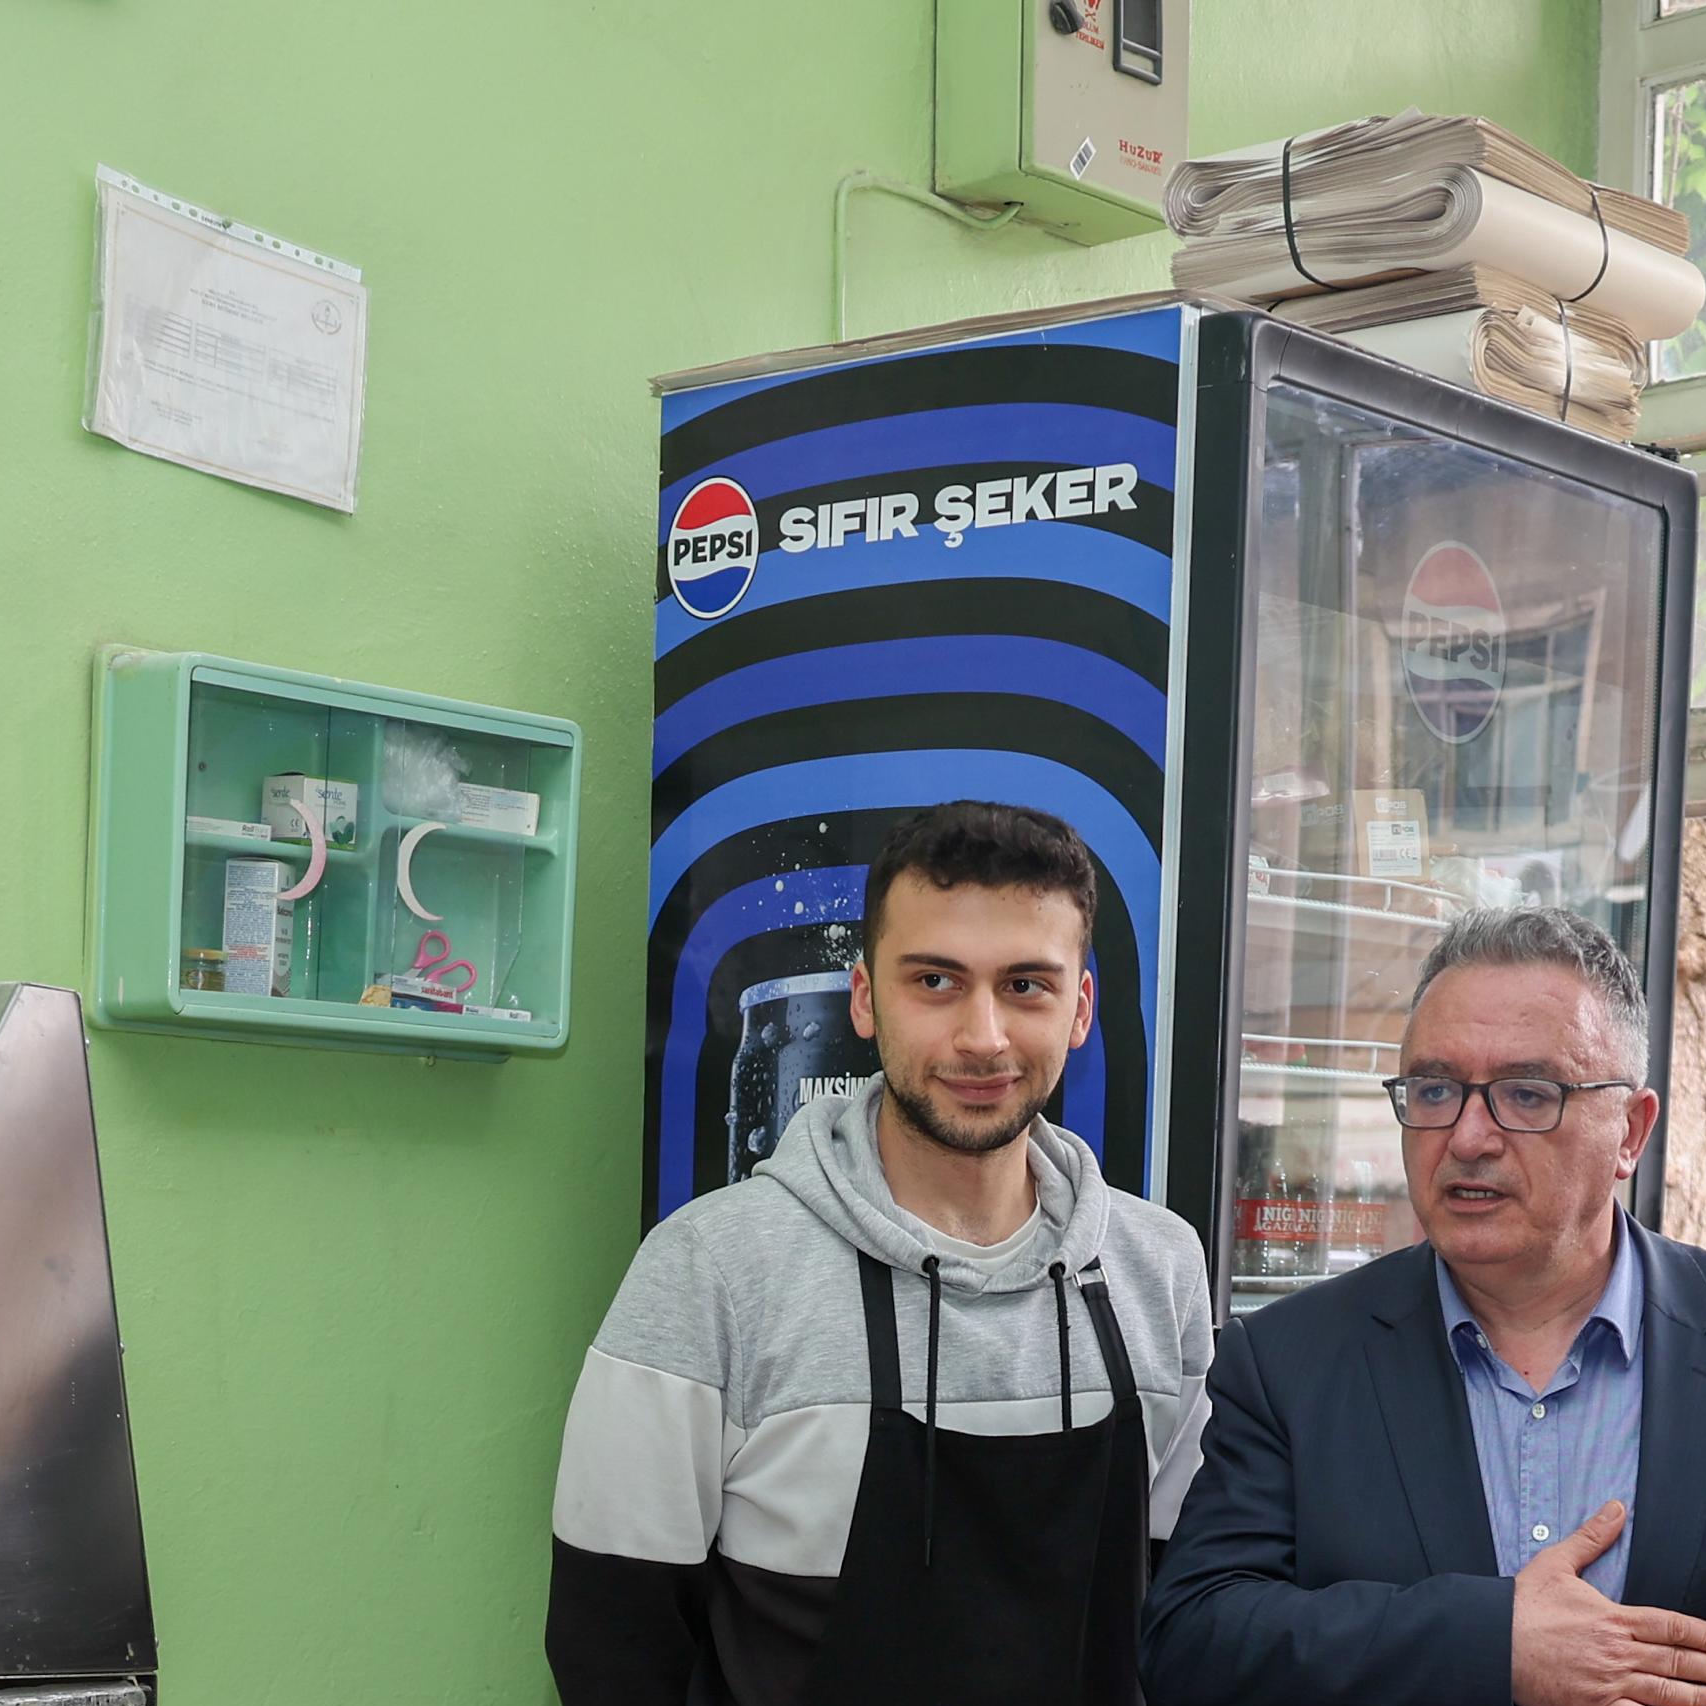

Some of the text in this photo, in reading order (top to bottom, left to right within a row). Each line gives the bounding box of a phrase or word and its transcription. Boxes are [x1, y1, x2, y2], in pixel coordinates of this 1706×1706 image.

[778, 462, 1139, 554] SIFIR ŞEKER
[674, 527, 754, 567] PEPSI
[1408, 610, 1500, 674] PEPSI
[1263, 1203, 1293, 1221] NİĞ
